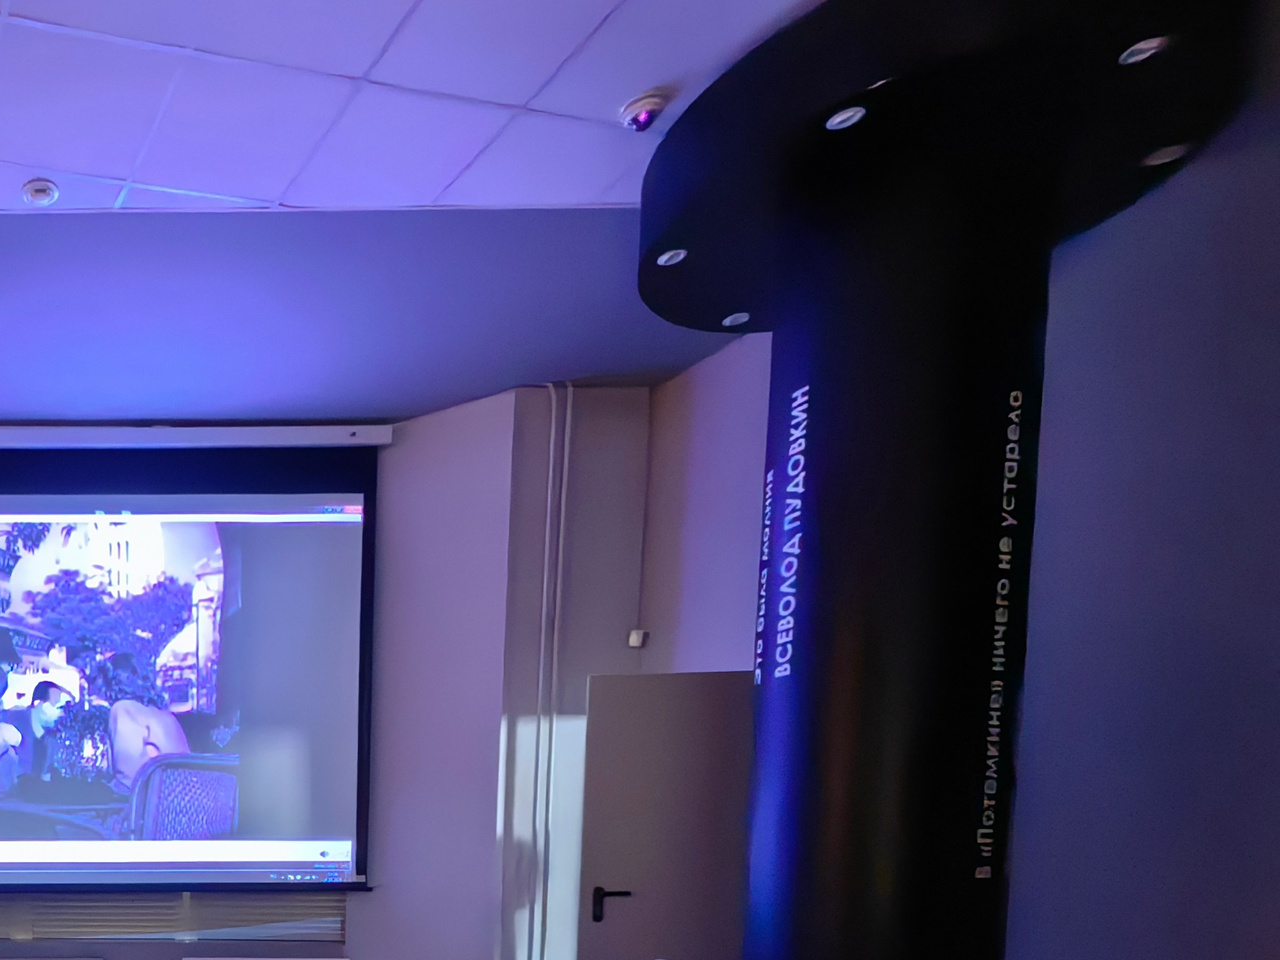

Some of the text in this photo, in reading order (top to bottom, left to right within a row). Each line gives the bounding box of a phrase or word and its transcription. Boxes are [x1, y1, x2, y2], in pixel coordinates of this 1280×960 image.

[1001, 390, 1023, 527] устарело
[774, 532, 802, 678] ВСЕВОЛОД
[998, 536, 1012, 570] не
[992, 578, 1010, 671] ничего
